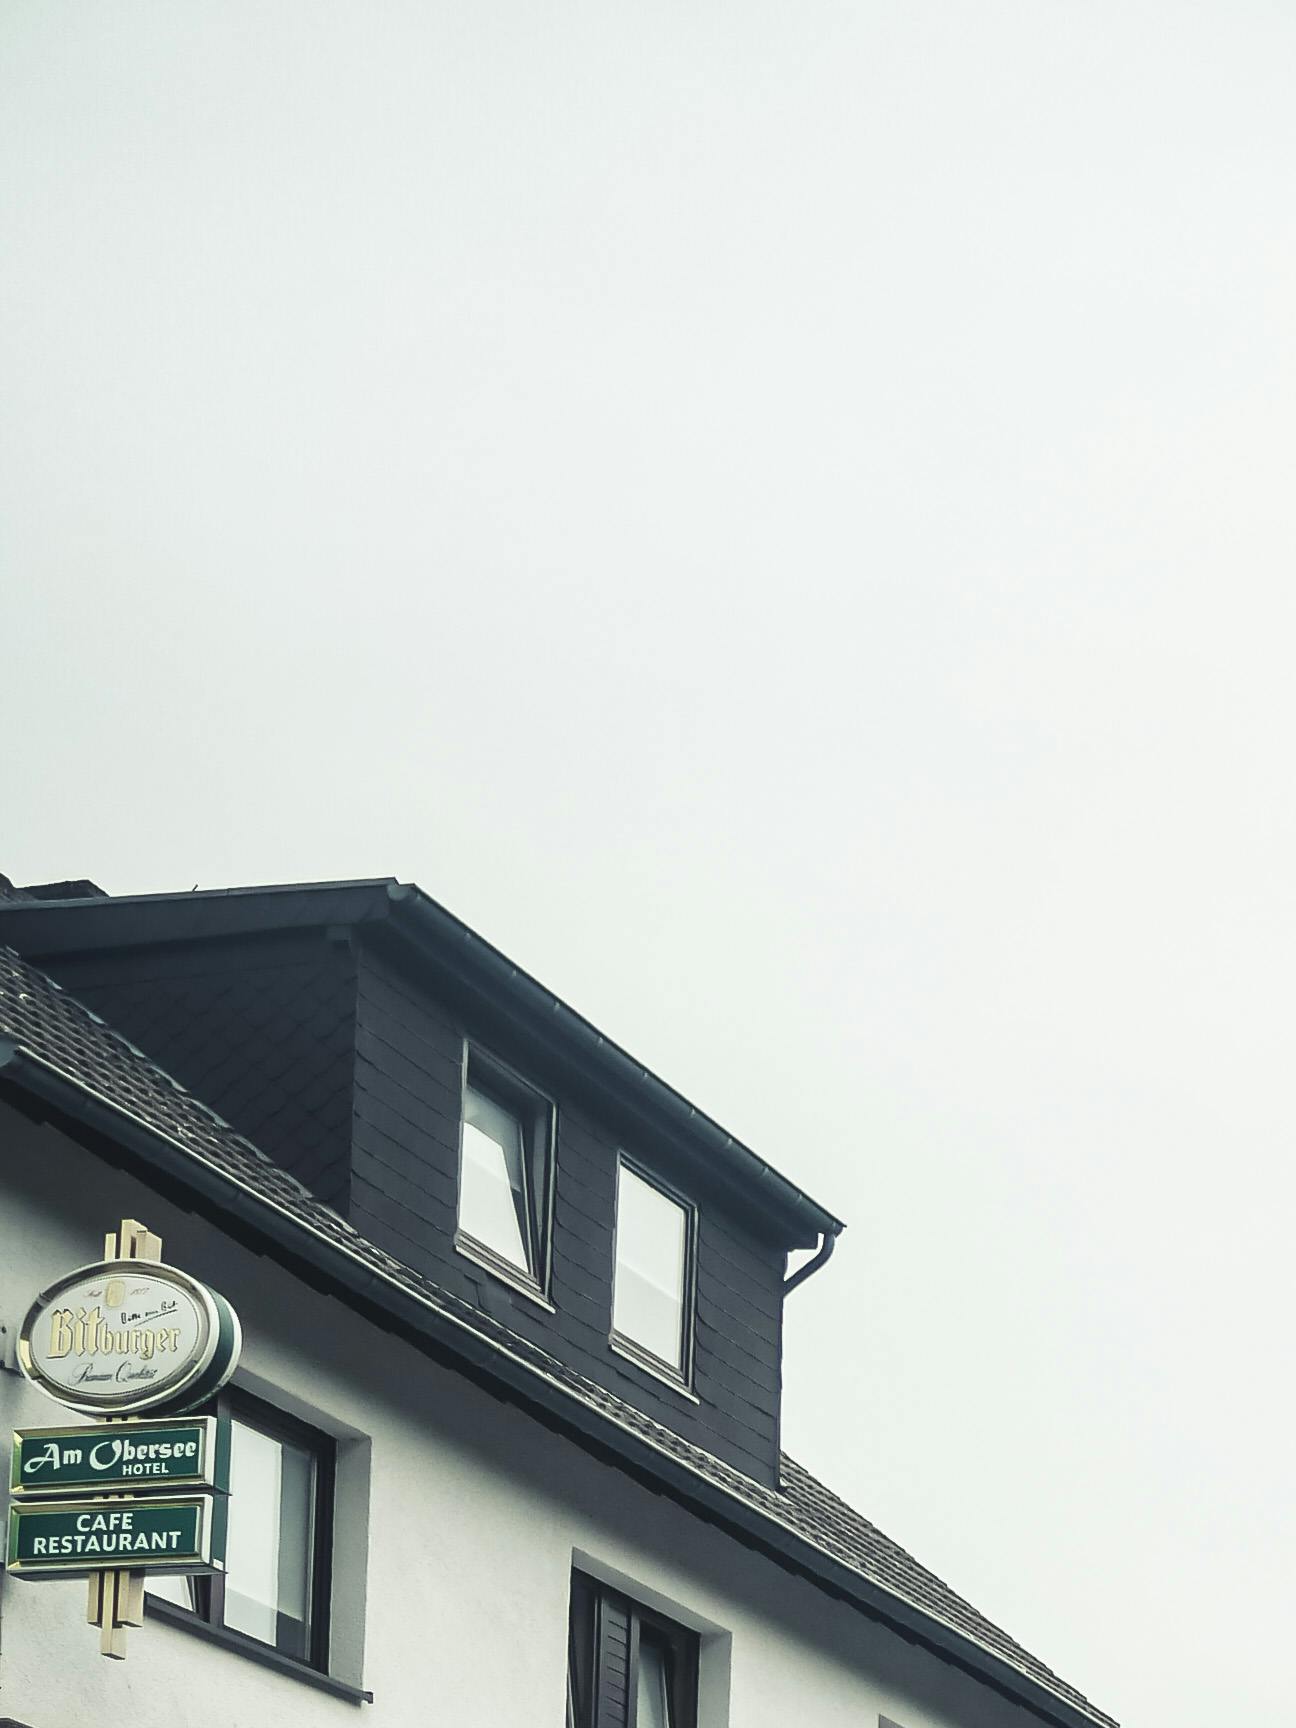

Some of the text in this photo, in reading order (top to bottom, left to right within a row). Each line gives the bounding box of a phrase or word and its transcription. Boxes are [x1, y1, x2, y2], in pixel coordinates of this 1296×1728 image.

[46, 1305, 182, 1361] Bitburger
[24, 1440, 197, 1473] Am Obersee
[122, 1463, 169, 1476] HOTEL
[76, 1513, 134, 1532] CAFE
[33, 1531, 182, 1555] RESTAURANT
